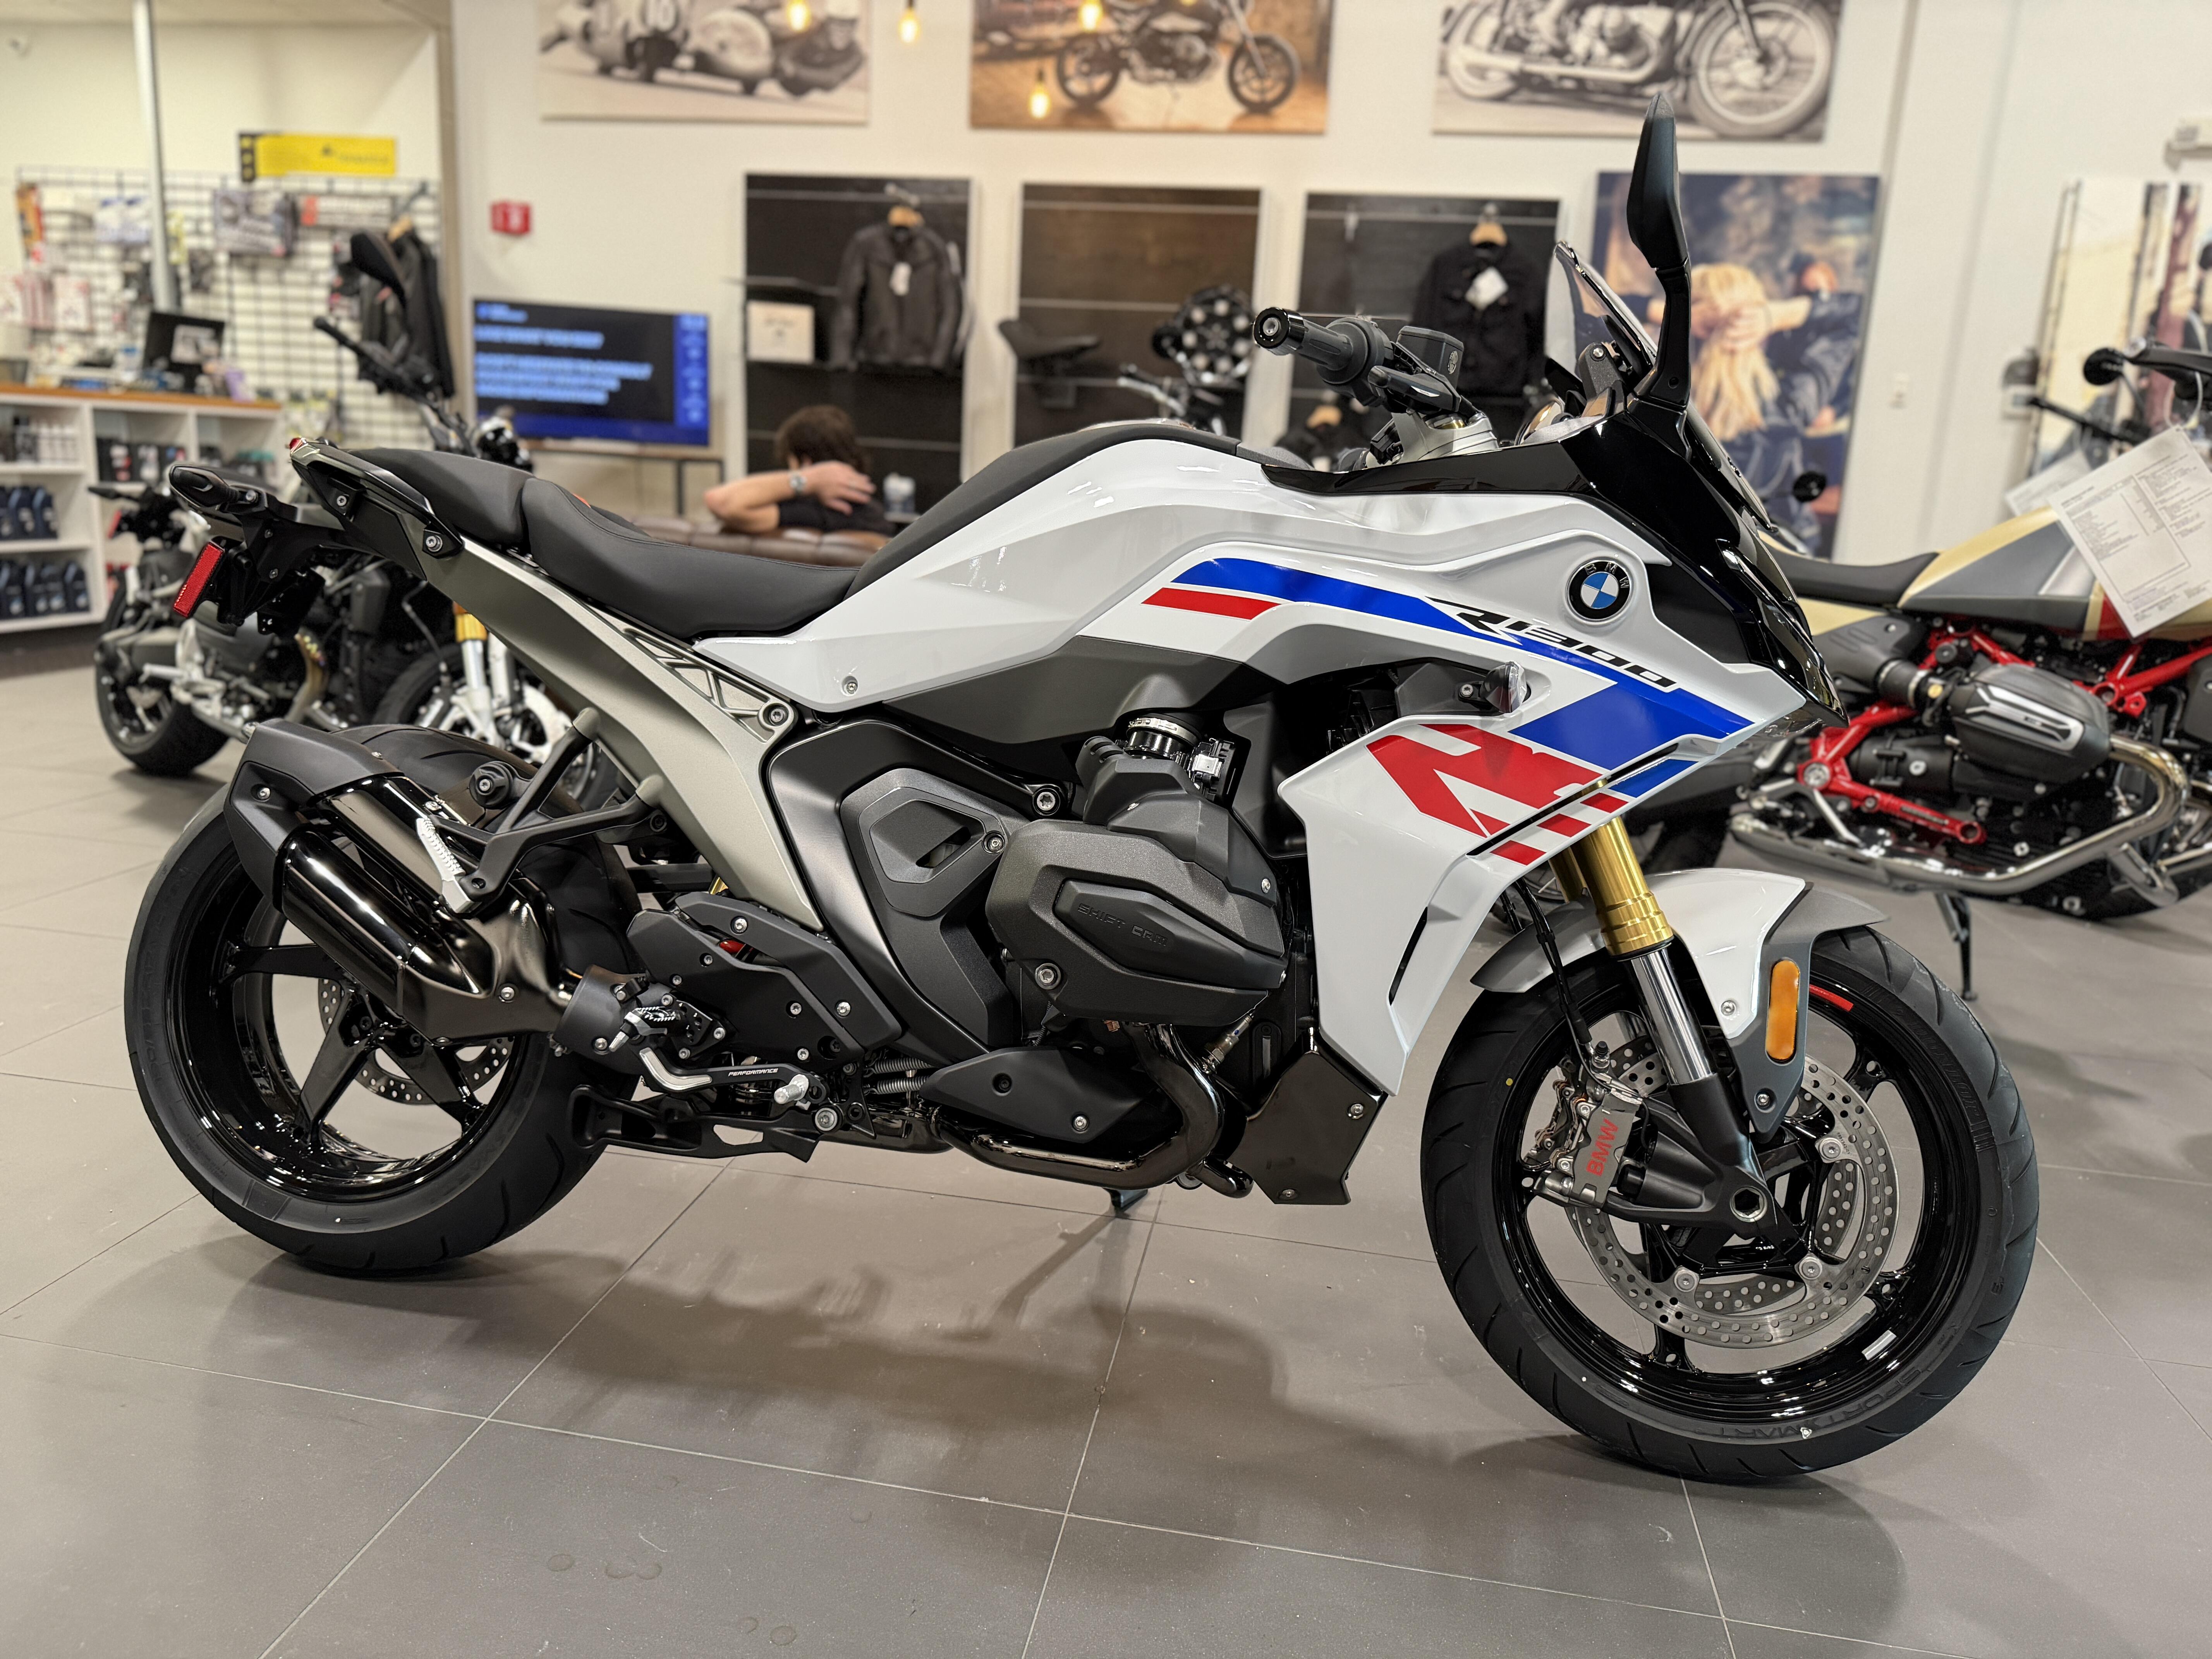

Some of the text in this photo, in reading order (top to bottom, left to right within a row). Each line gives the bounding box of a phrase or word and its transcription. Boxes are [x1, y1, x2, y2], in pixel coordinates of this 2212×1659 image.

[1585, 562, 1630, 589] BMW
[1077, 903, 1168, 947] SHIFT CAM
[728, 1068, 779, 1077] PERFORMANCE
[1586, 1118, 1618, 1176] BMW
